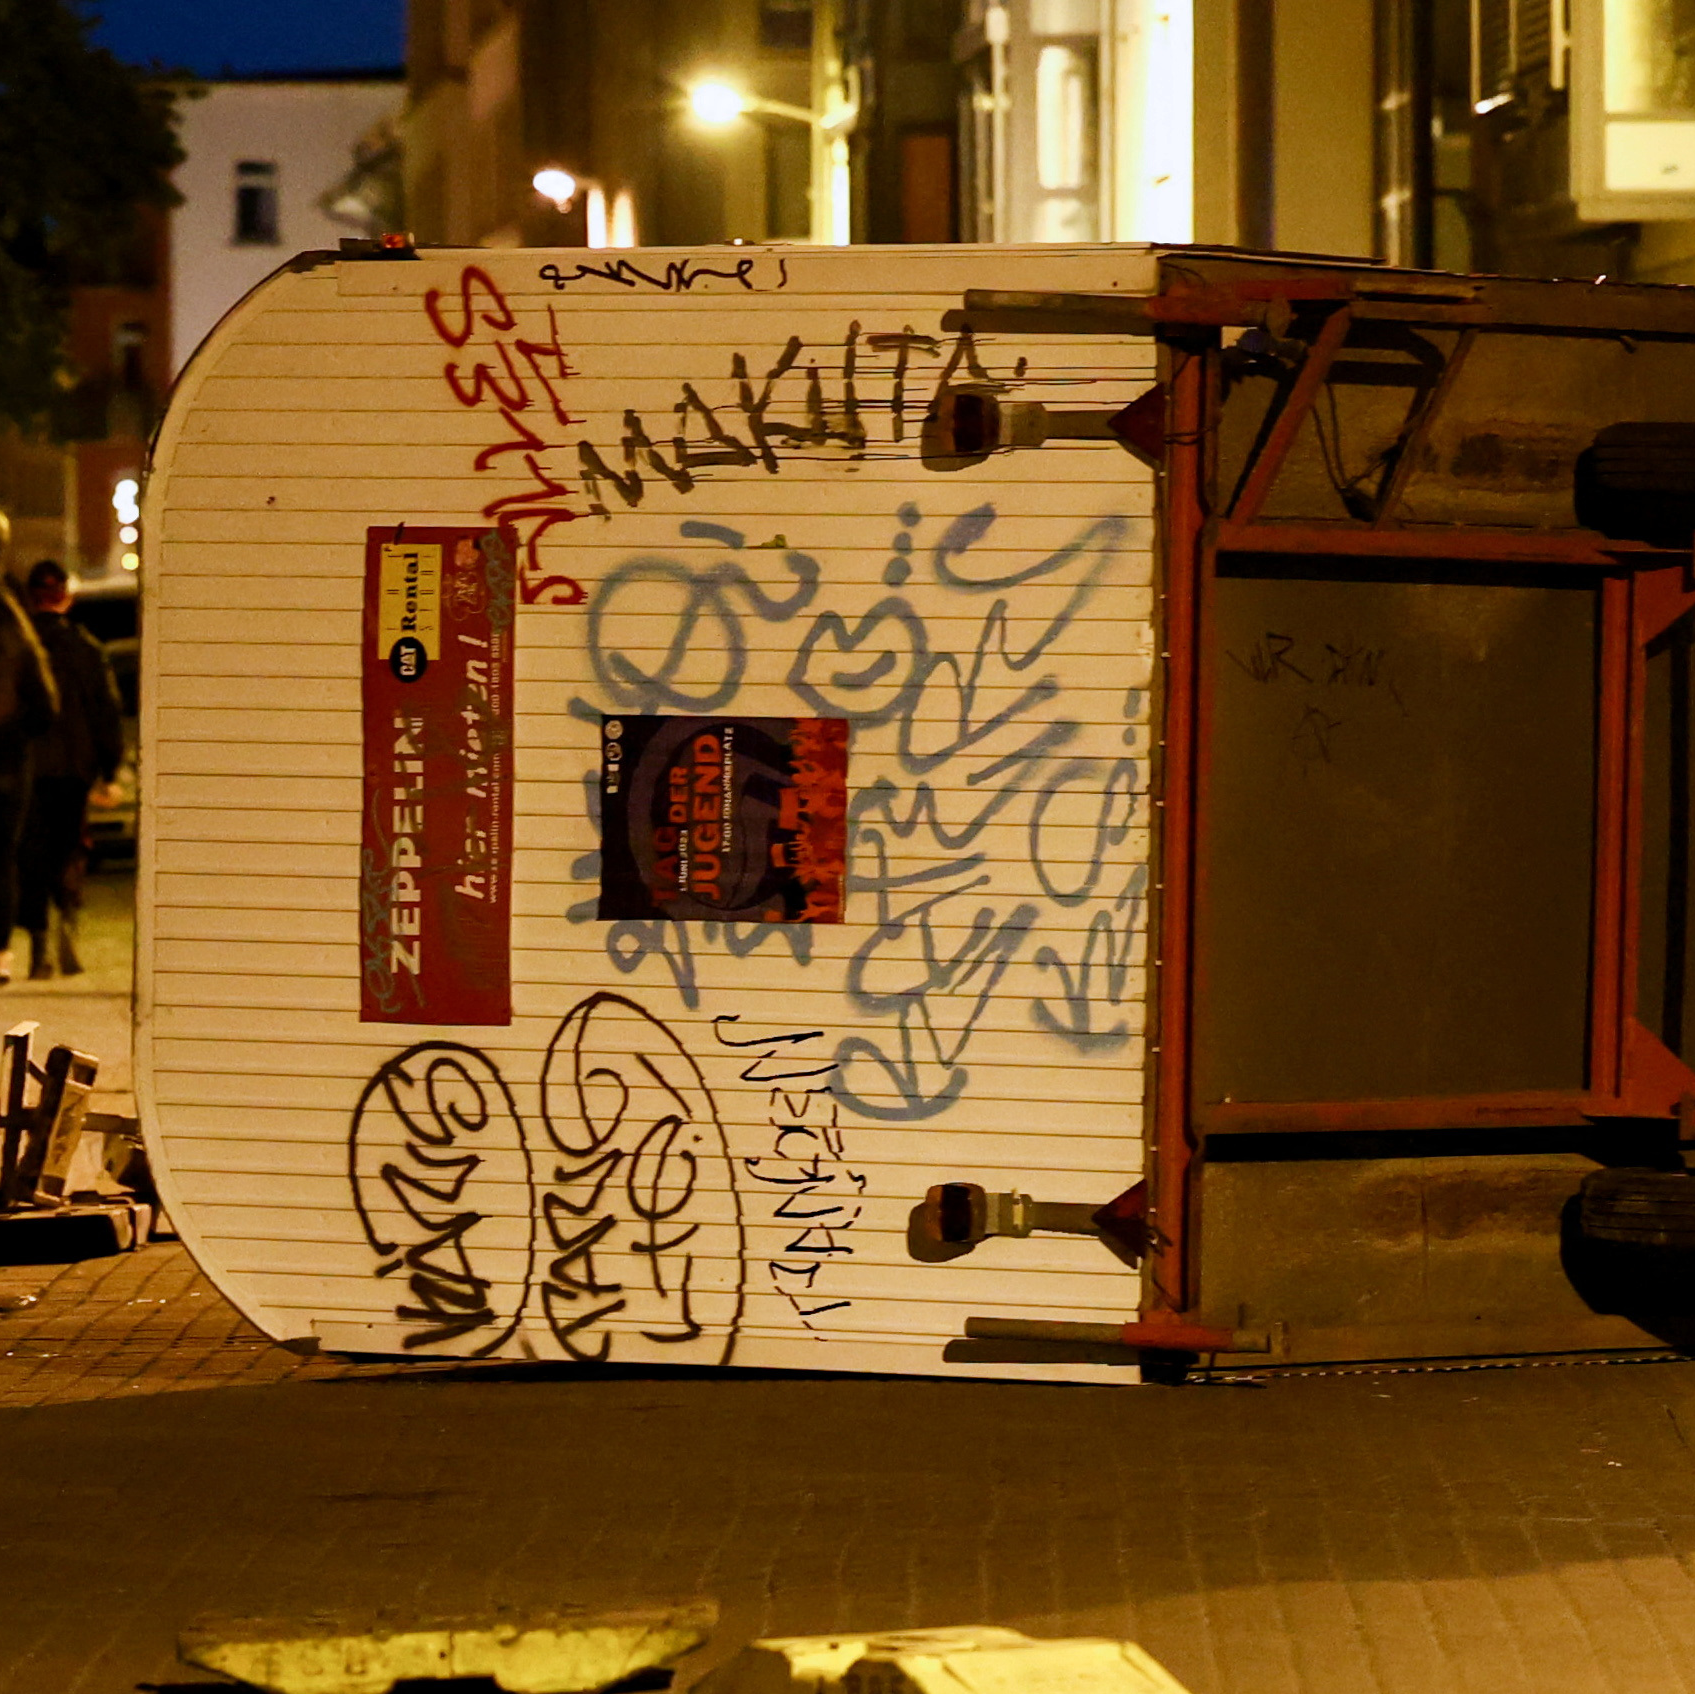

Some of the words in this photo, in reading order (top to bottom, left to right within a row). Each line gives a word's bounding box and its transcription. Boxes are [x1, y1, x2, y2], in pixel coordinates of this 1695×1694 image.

[400, 552, 419, 633] Rental
[399, 645, 417, 676] CAT
[668, 766, 689, 824] DER
[691, 733, 722, 901] JUGEND
[389, 716, 425, 975] ZEPPELIN
[650, 826, 678, 907] TAG
